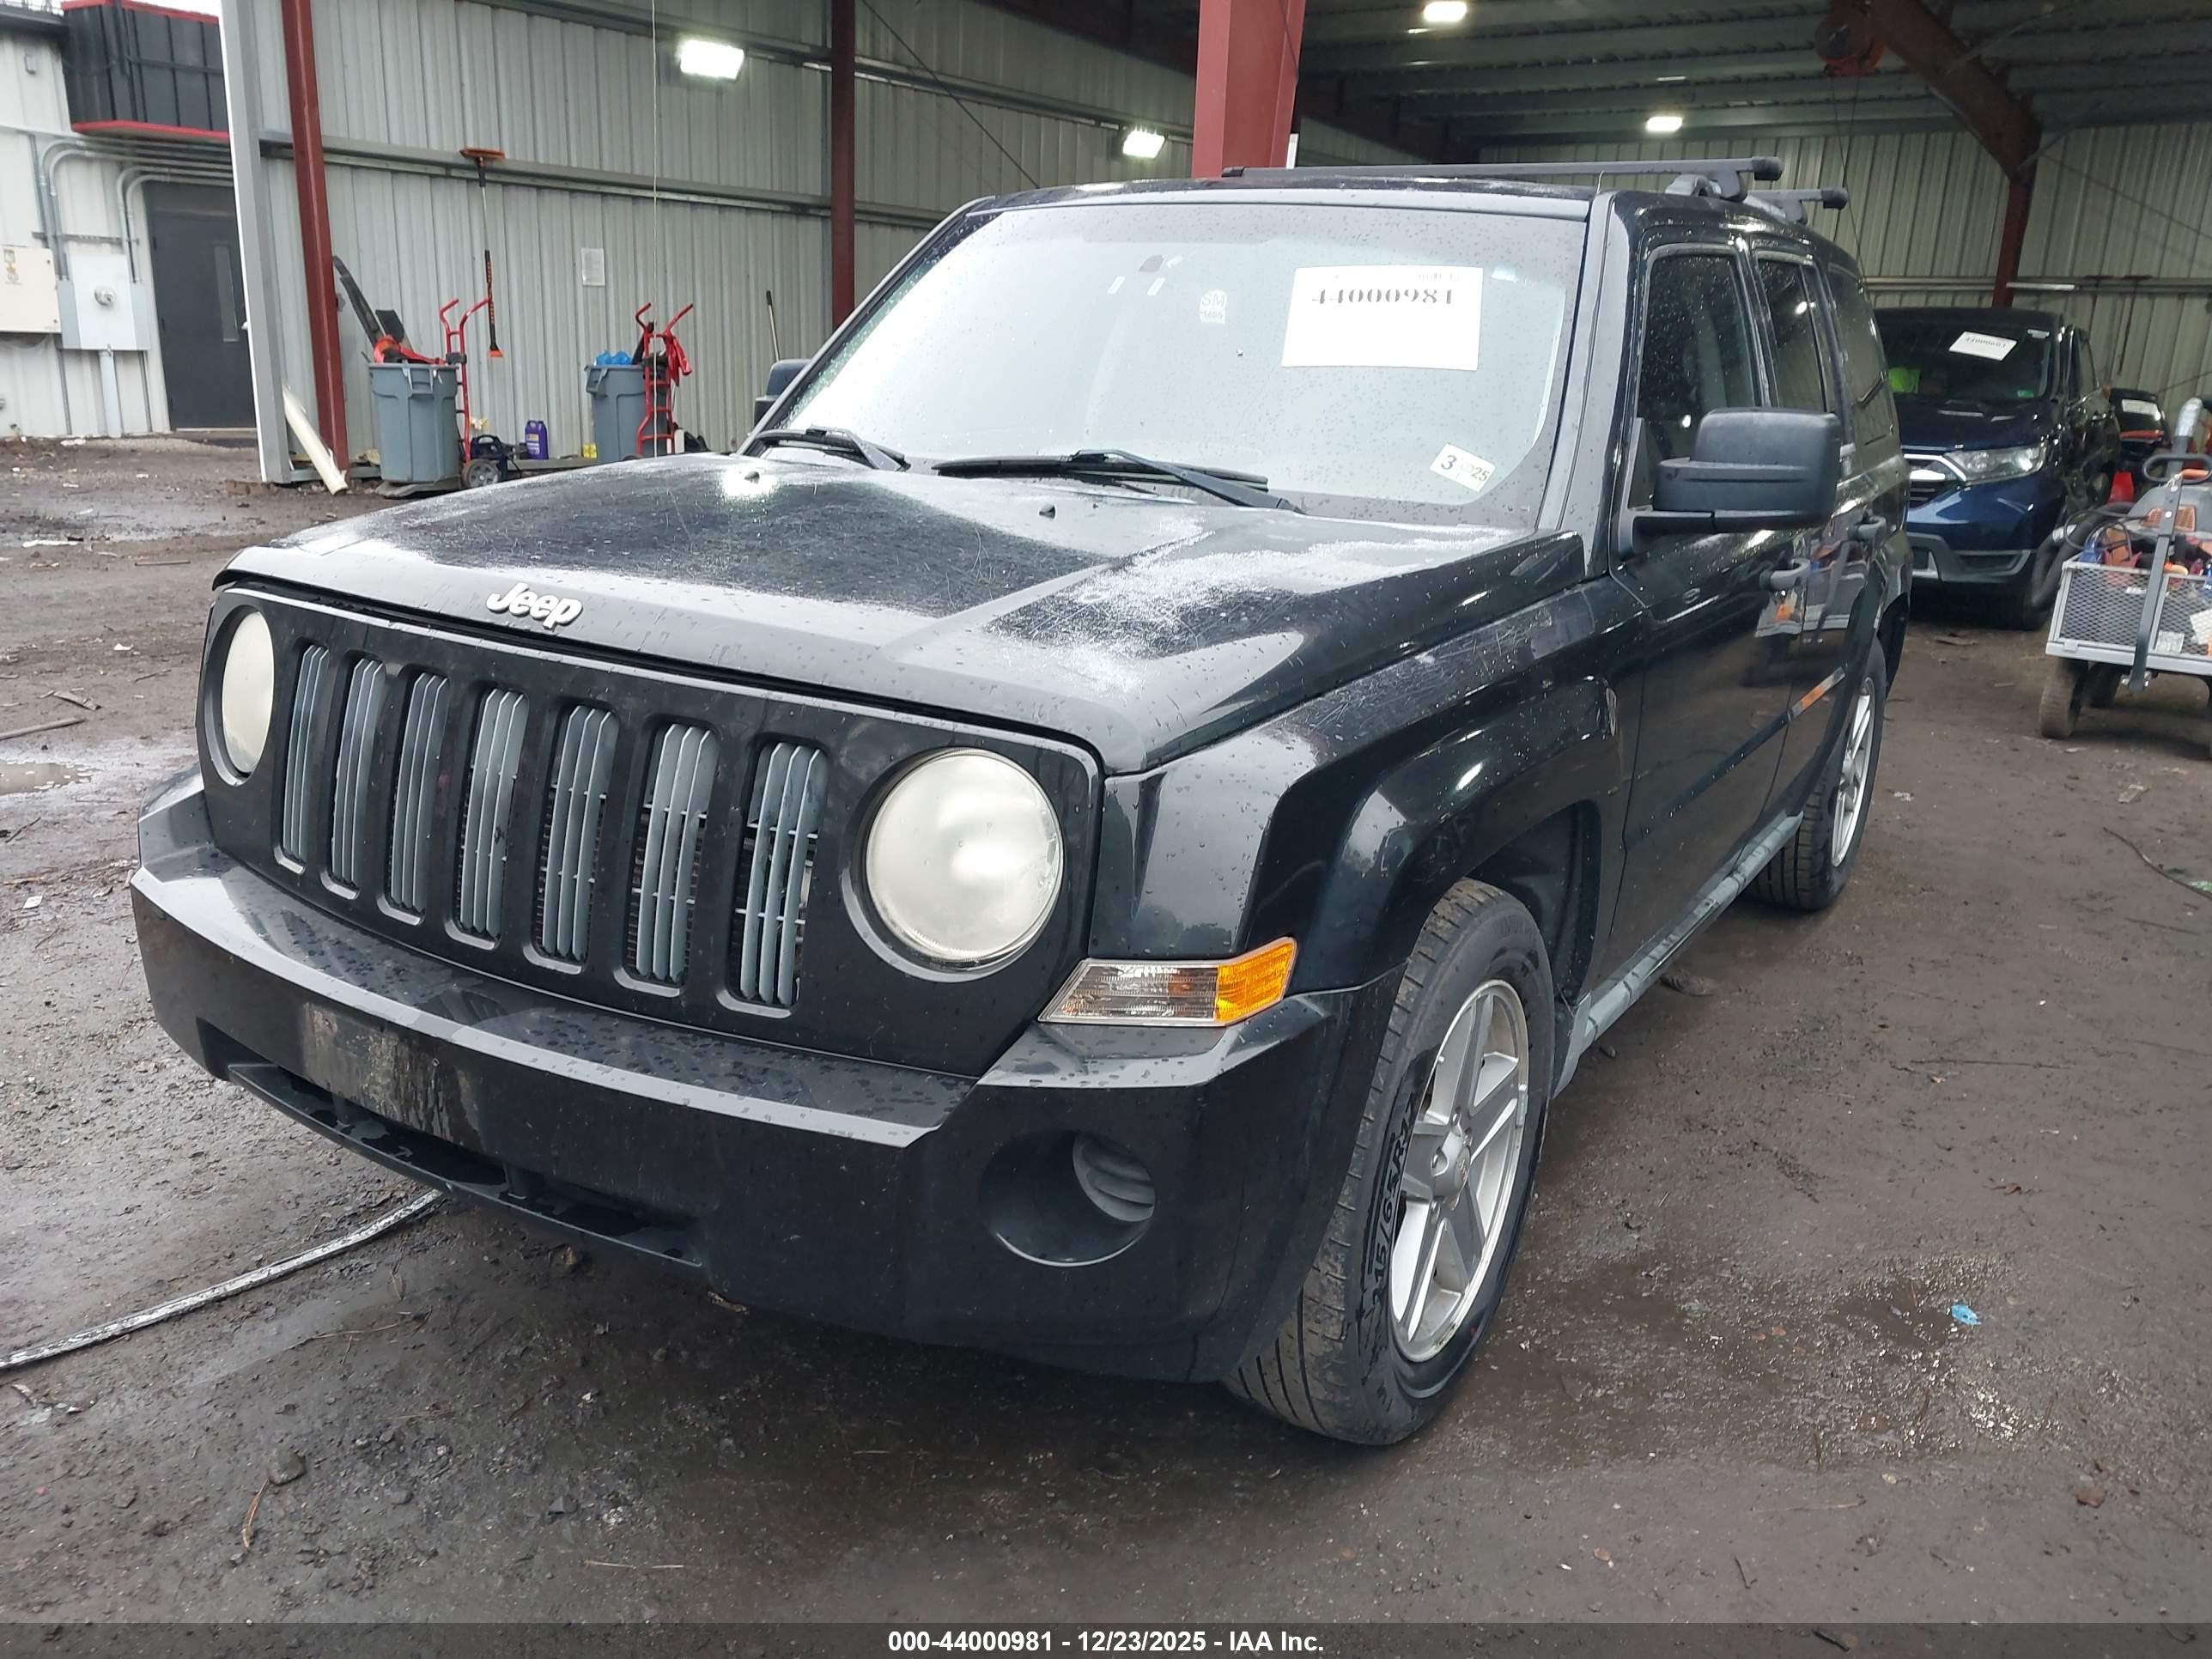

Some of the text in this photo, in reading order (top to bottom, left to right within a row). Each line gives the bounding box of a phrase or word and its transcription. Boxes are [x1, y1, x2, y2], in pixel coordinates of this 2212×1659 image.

[1440, 454, 1491, 482] 3 25
[486, 582, 583, 631] Jeep
